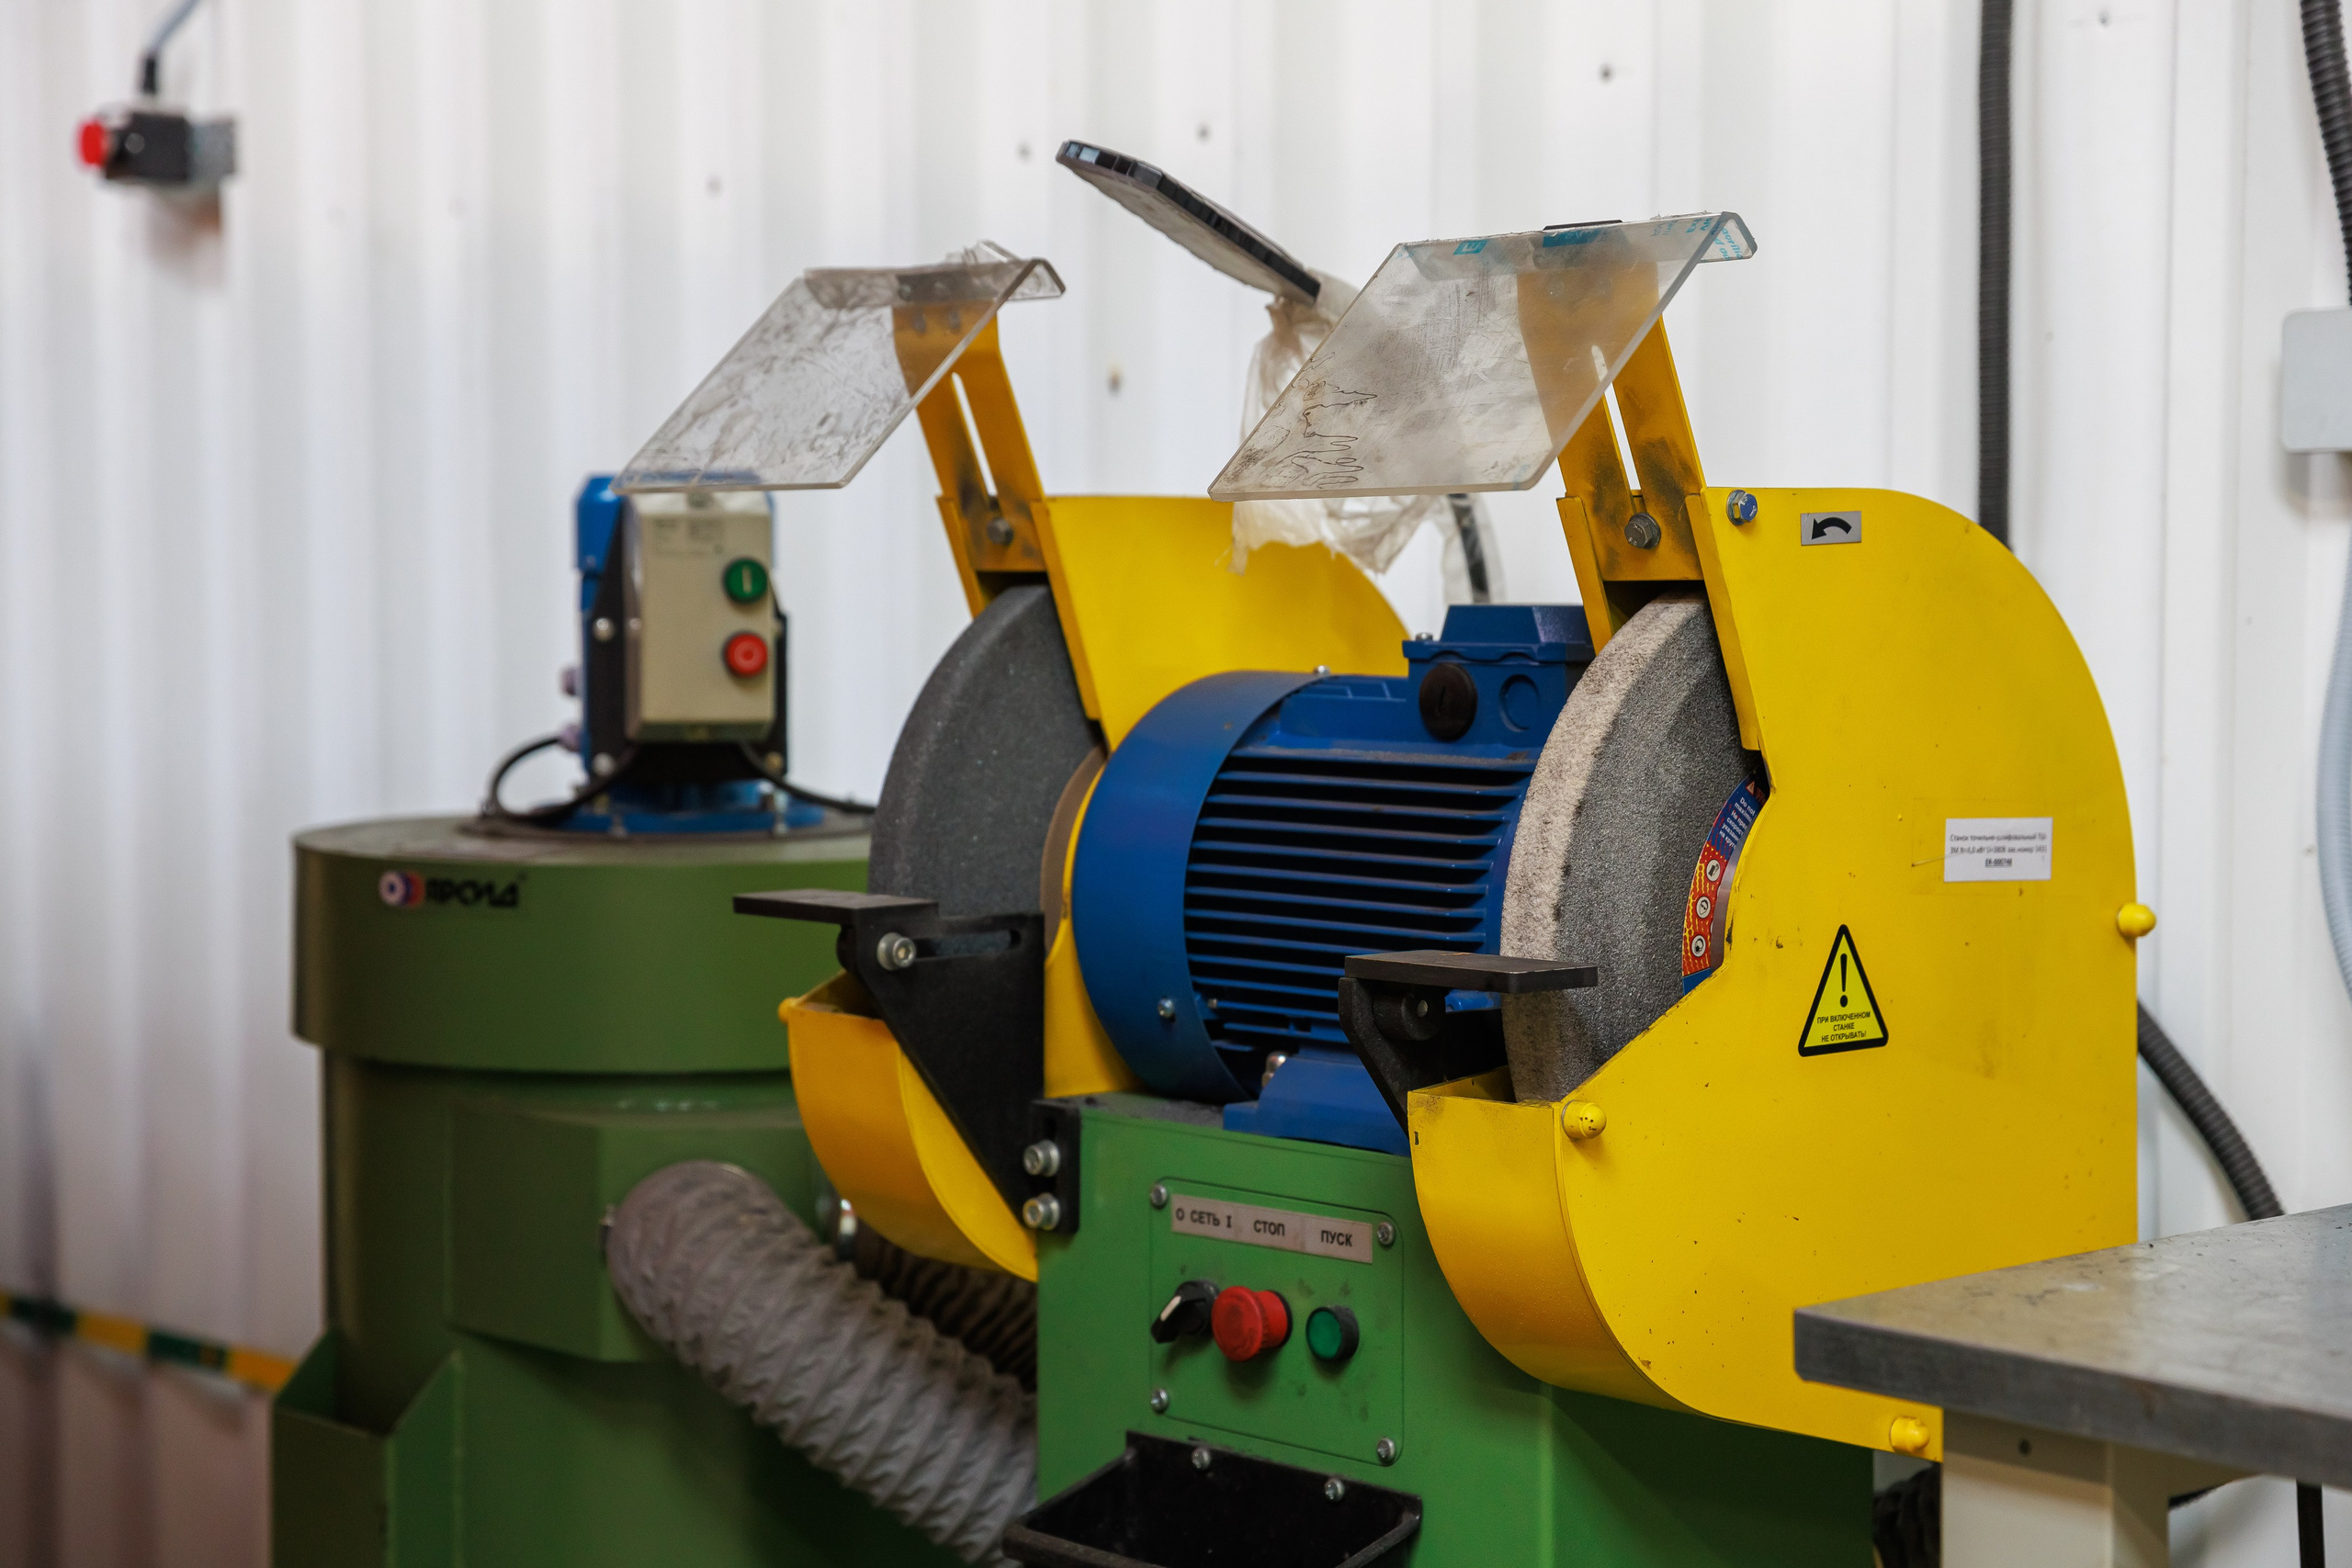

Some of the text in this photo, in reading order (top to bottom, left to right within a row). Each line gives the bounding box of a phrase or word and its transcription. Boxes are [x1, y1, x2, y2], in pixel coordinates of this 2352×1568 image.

[1830, 1011, 1871, 1022] ВКЛЮЧЕННОМ
[1833, 1022, 1855, 1032] СТАНКЕ
[1821, 1031, 1867, 1043] НЕ ОТКРЫВАТЬ!
[1190, 1209, 1221, 1226] СЕТЬ
[1253, 1220, 1285, 1236] СТОП
[1320, 1229, 1353, 1247] ПУСК
